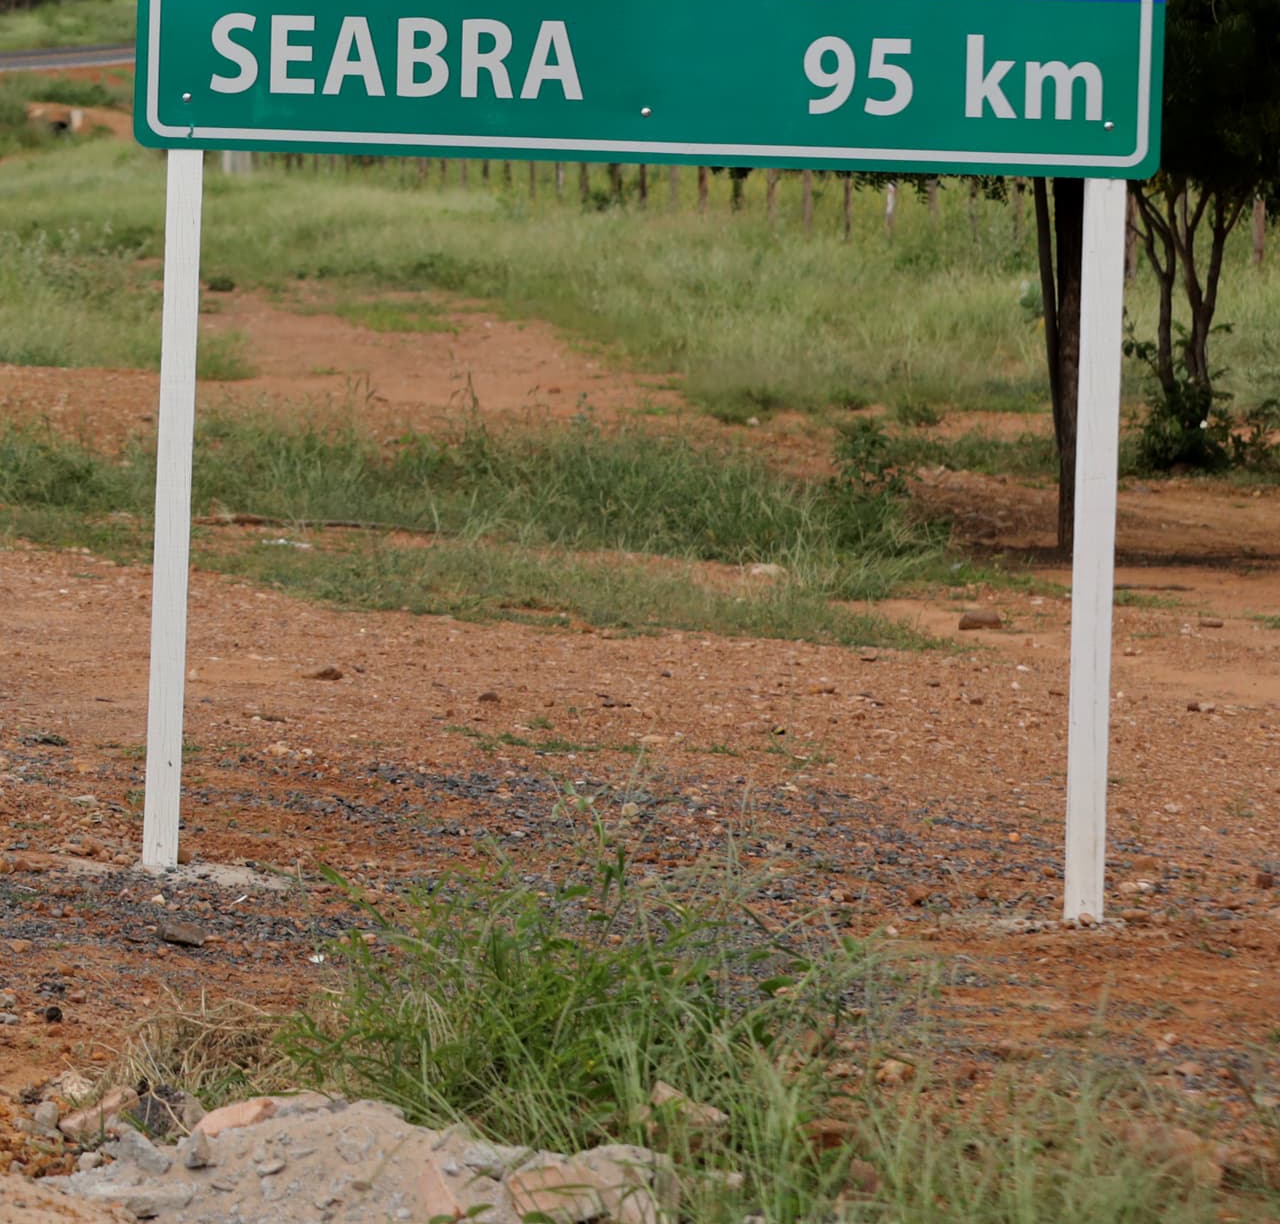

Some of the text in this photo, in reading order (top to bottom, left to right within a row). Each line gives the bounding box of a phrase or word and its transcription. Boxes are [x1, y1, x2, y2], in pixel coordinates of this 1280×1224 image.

[210, 13, 1102, 121] SEABRA 95 km
